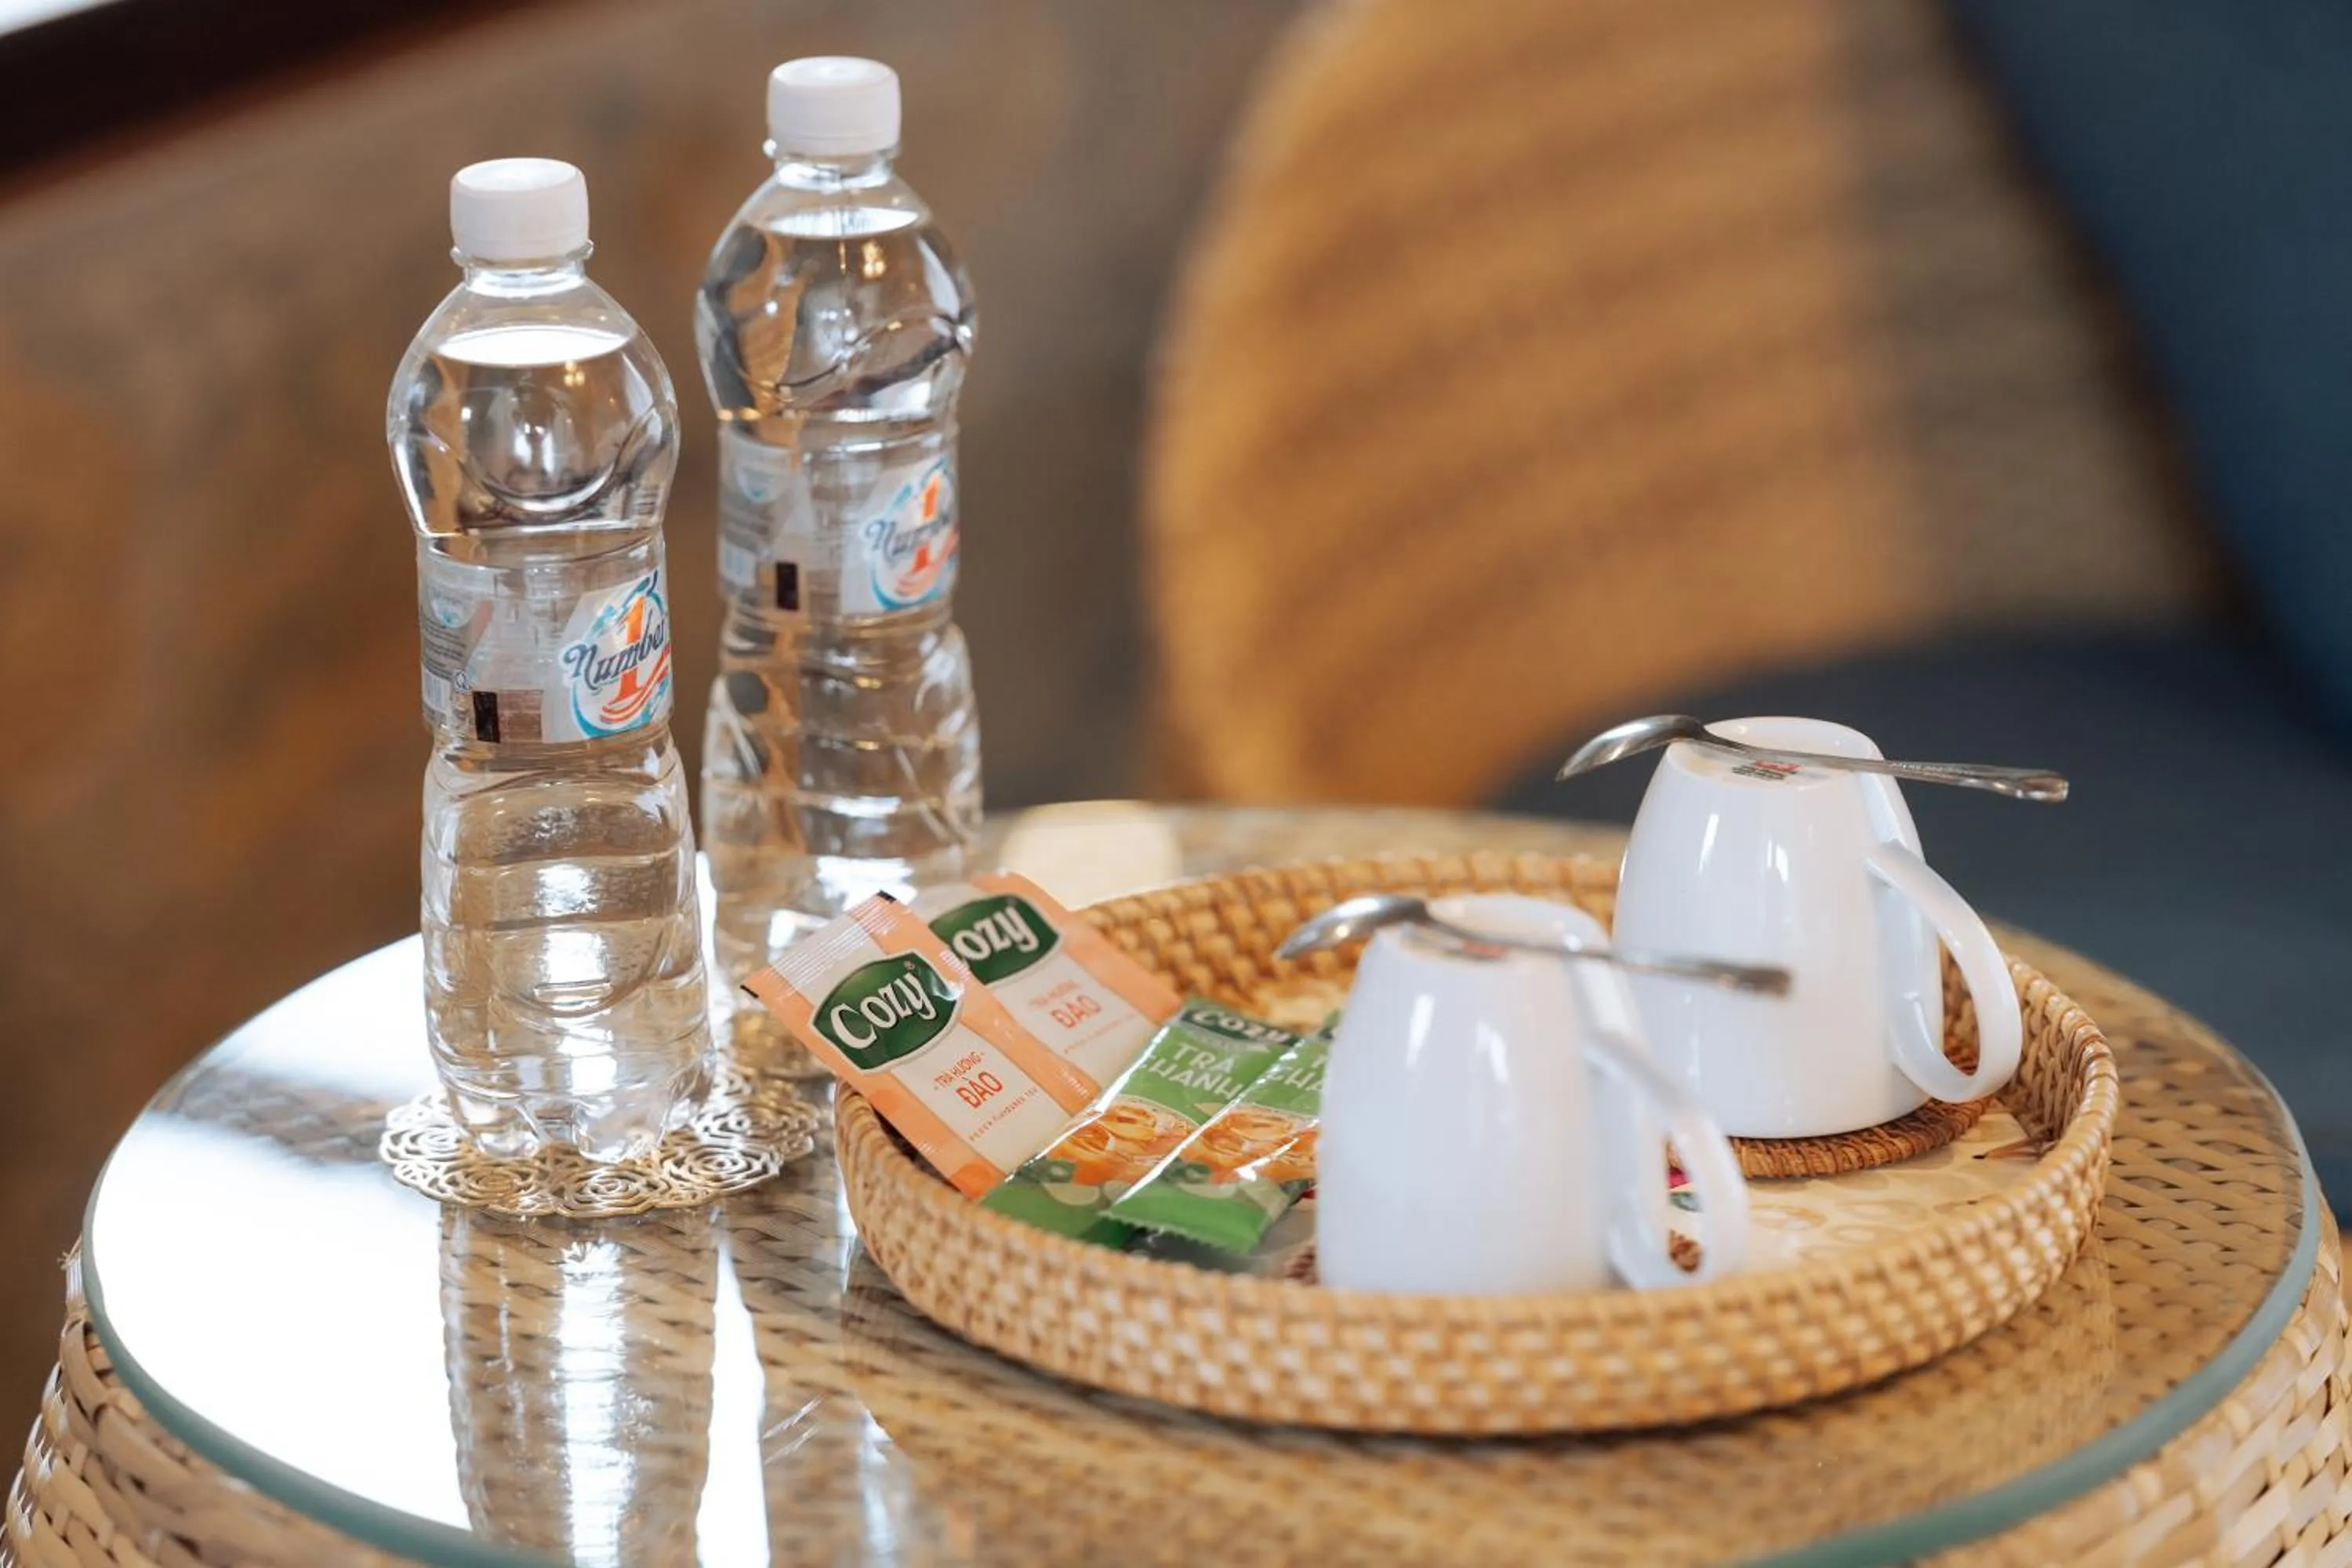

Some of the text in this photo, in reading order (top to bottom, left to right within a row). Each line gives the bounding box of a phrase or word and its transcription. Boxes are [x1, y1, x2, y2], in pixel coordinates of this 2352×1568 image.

[953, 906, 1039, 960] ozy
[830, 972, 936, 1050] Cozy
[956, 1071, 1003, 1109] ĐÀO
